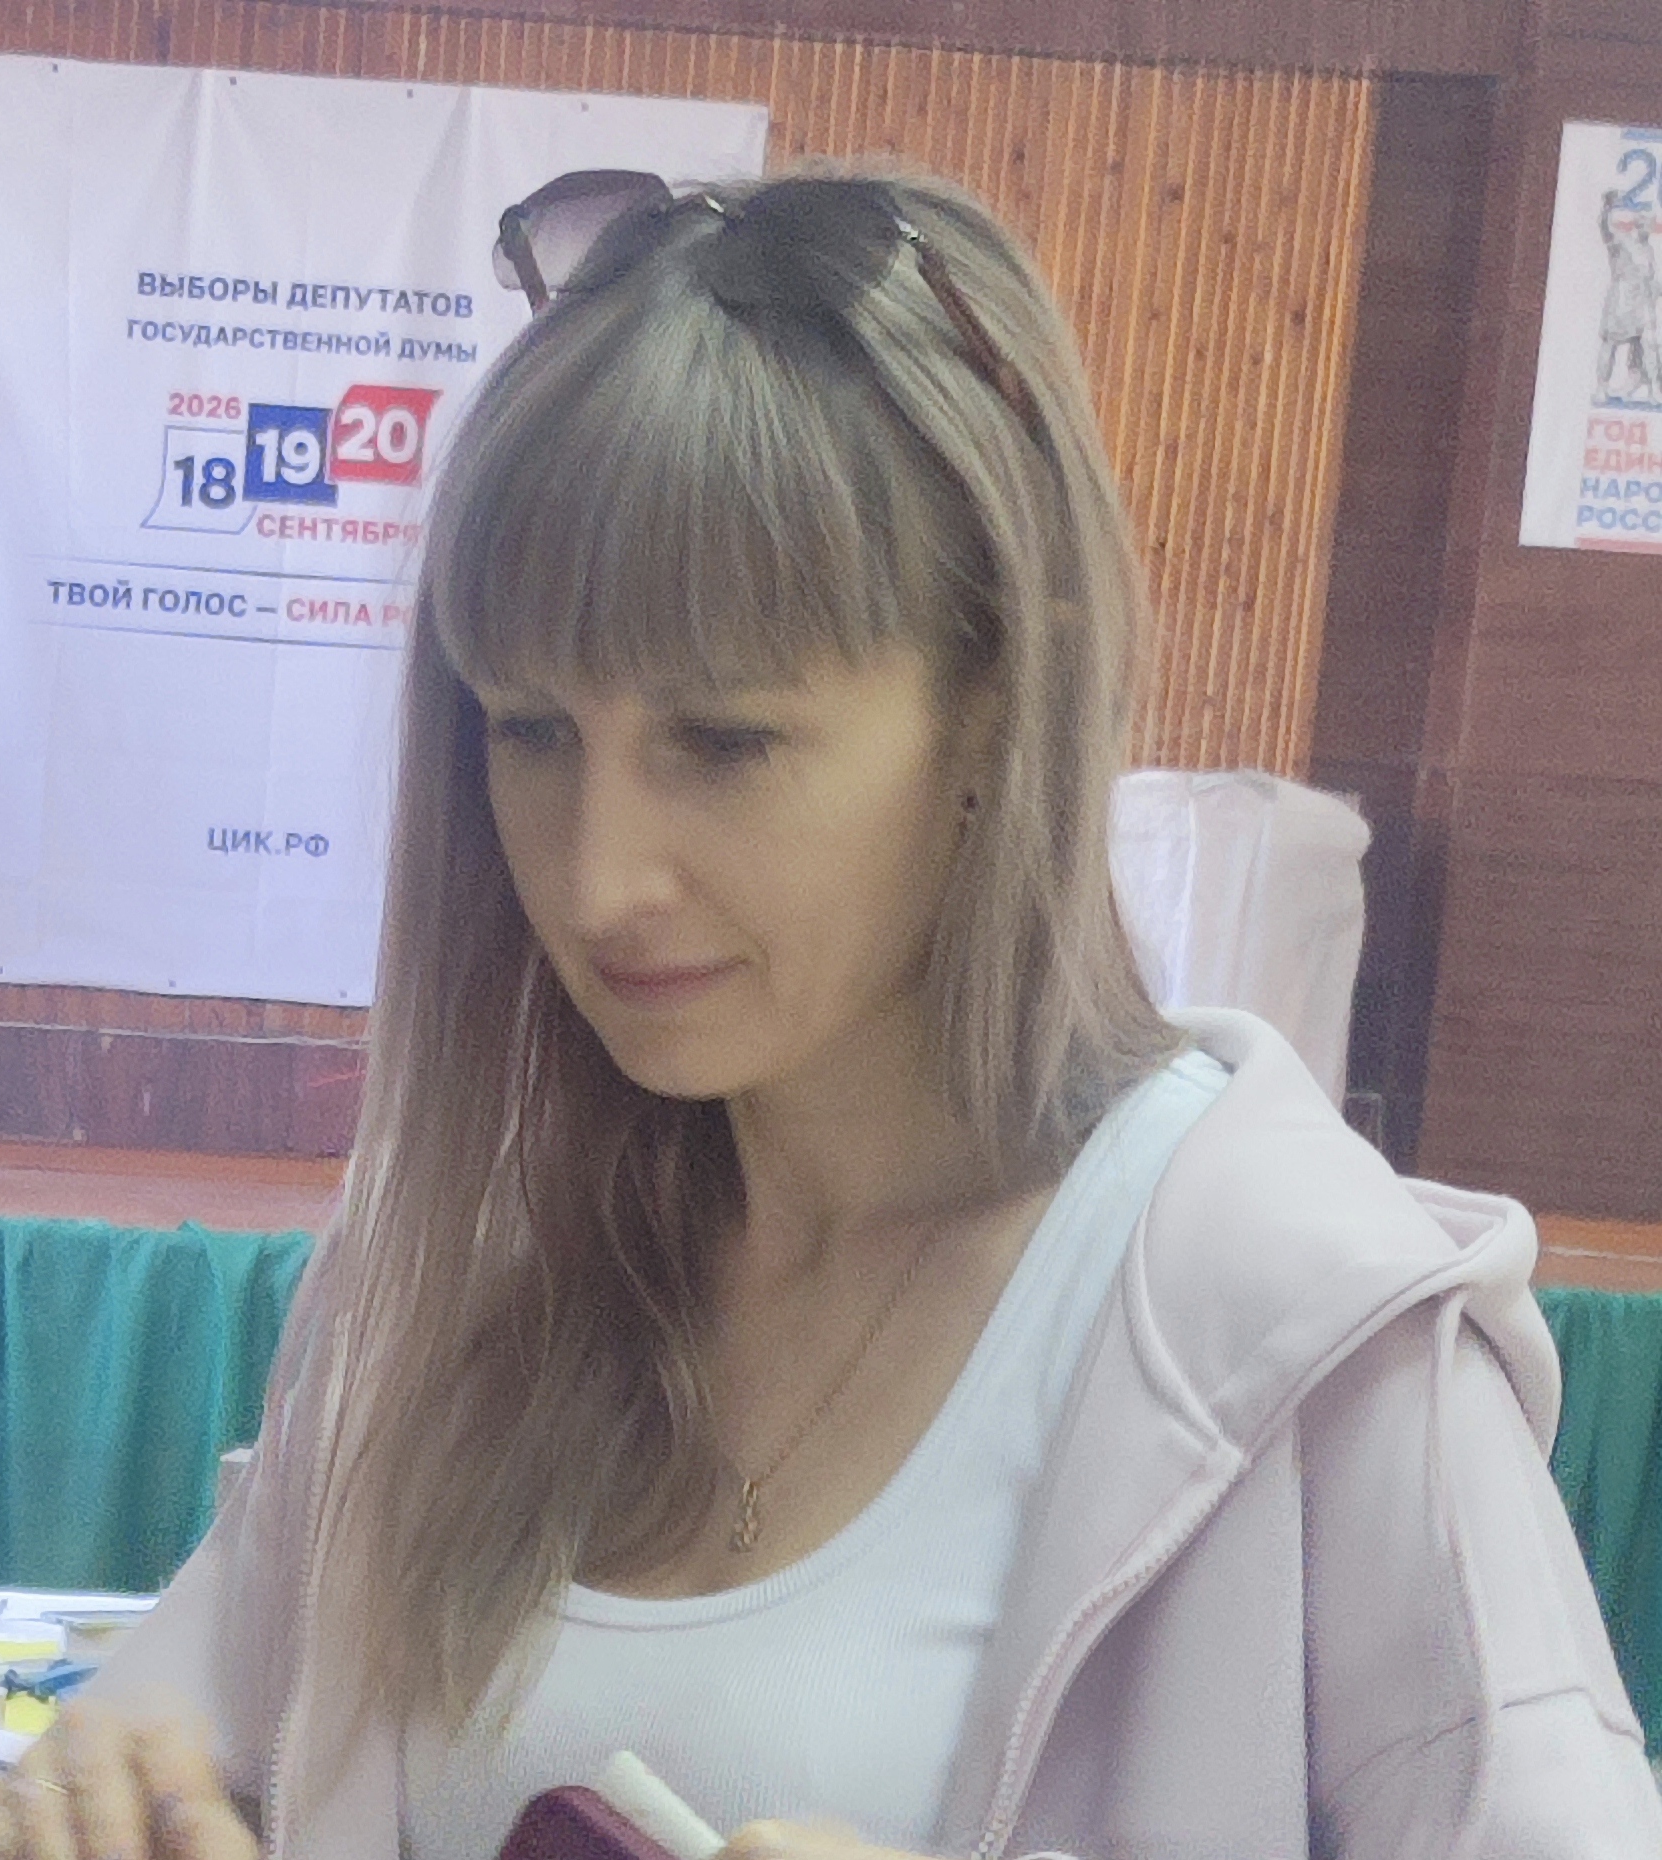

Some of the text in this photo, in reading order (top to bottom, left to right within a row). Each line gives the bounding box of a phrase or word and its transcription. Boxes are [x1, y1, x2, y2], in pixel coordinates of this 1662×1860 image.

[137, 271, 474, 318] ВЫБОРЫ ДЕПУТАТОВ
[126, 319, 478, 364] ГОСУДАРСТВЕННОЙ ДУМЫ
[167, 391, 242, 419] 2026
[1586, 416, 1648, 446] ГОД
[173, 404, 419, 510] 18 19 20
[47, 578, 133, 610] ТВОЙ
[141, 586, 248, 618] ГОЛОС
[286, 597, 373, 627] СИЛА
[207, 826, 330, 858] ЦИК.РФ
